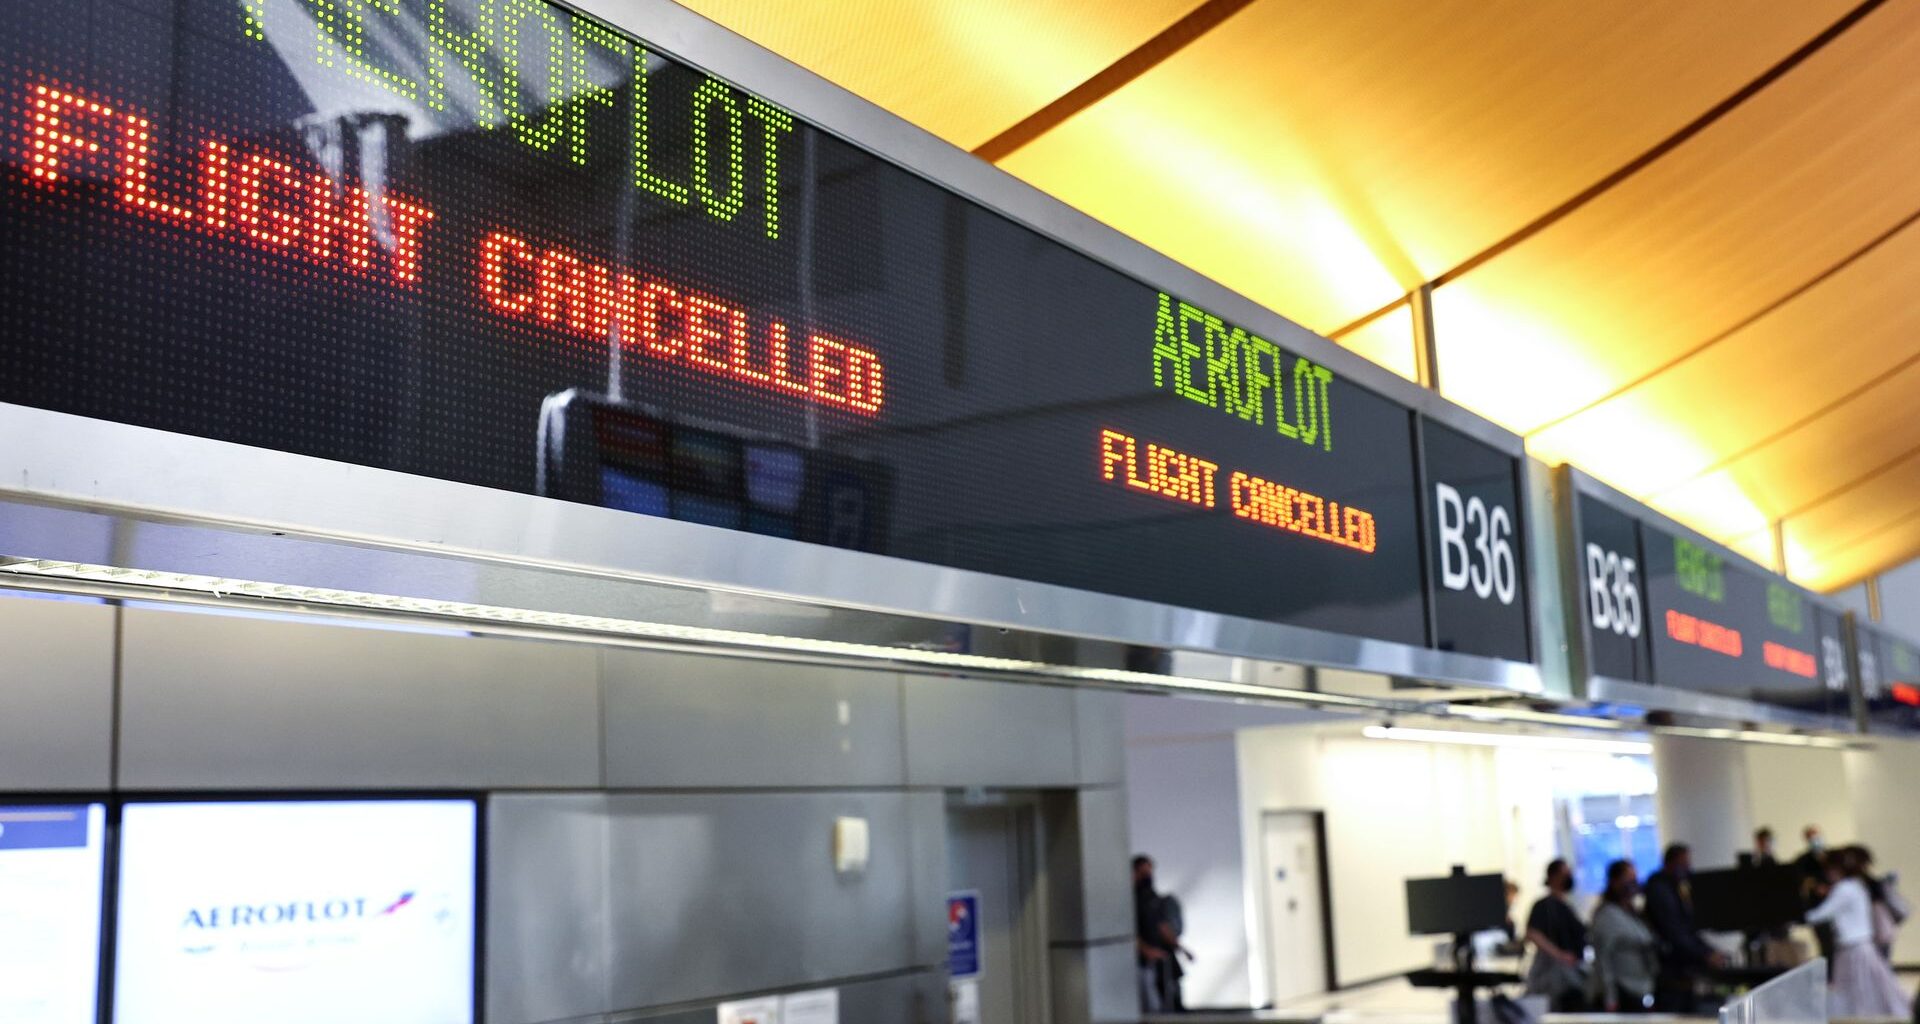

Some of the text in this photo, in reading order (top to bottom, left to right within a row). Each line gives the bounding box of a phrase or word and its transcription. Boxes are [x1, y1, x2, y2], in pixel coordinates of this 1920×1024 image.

[243, 0, 794, 240] EROFLOT
[32, 84, 884, 413] FLIGHT CANCELLED
[1153, 292, 1333, 452] AEROFLOT
[1102, 430, 1376, 554] FLIGHT CANCELLED
[1436, 482, 1517, 606] B36
[1586, 542, 1642, 638] B35
[181, 897, 368, 929] AEROFLOT
